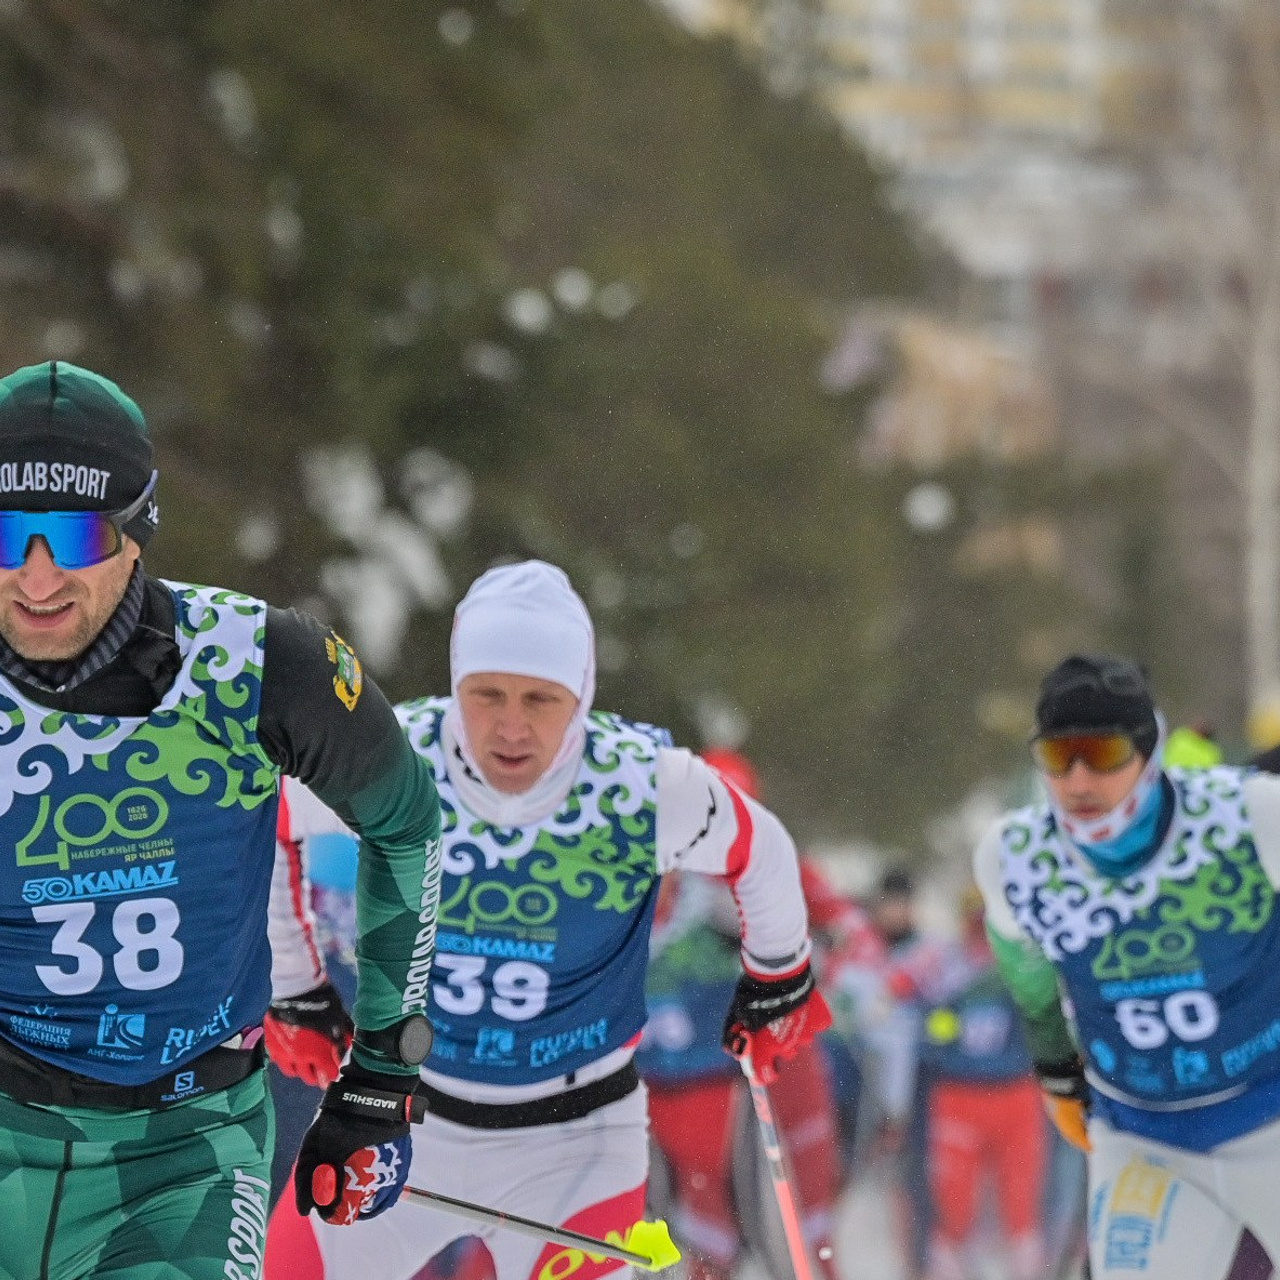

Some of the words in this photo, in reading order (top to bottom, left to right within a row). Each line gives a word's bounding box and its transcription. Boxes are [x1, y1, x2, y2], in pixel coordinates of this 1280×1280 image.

[16, 787, 169, 871] 400
[71, 844, 138, 860] НАБЕРЕЖНЫЕ
[138, 837, 174, 851] ЧЕЛНЫ
[124, 853, 138, 863] ЯР
[138, 847, 175, 861] ЧАЛЛЫ
[31, 897, 185, 996] 38
[432, 952, 552, 1022] 39
[9, 1014, 71, 1036] ФЕДЕРАЦИЯ
[1114, 989, 1219, 1050] 60
[342, 1092, 398, 1110] MADSHUS
